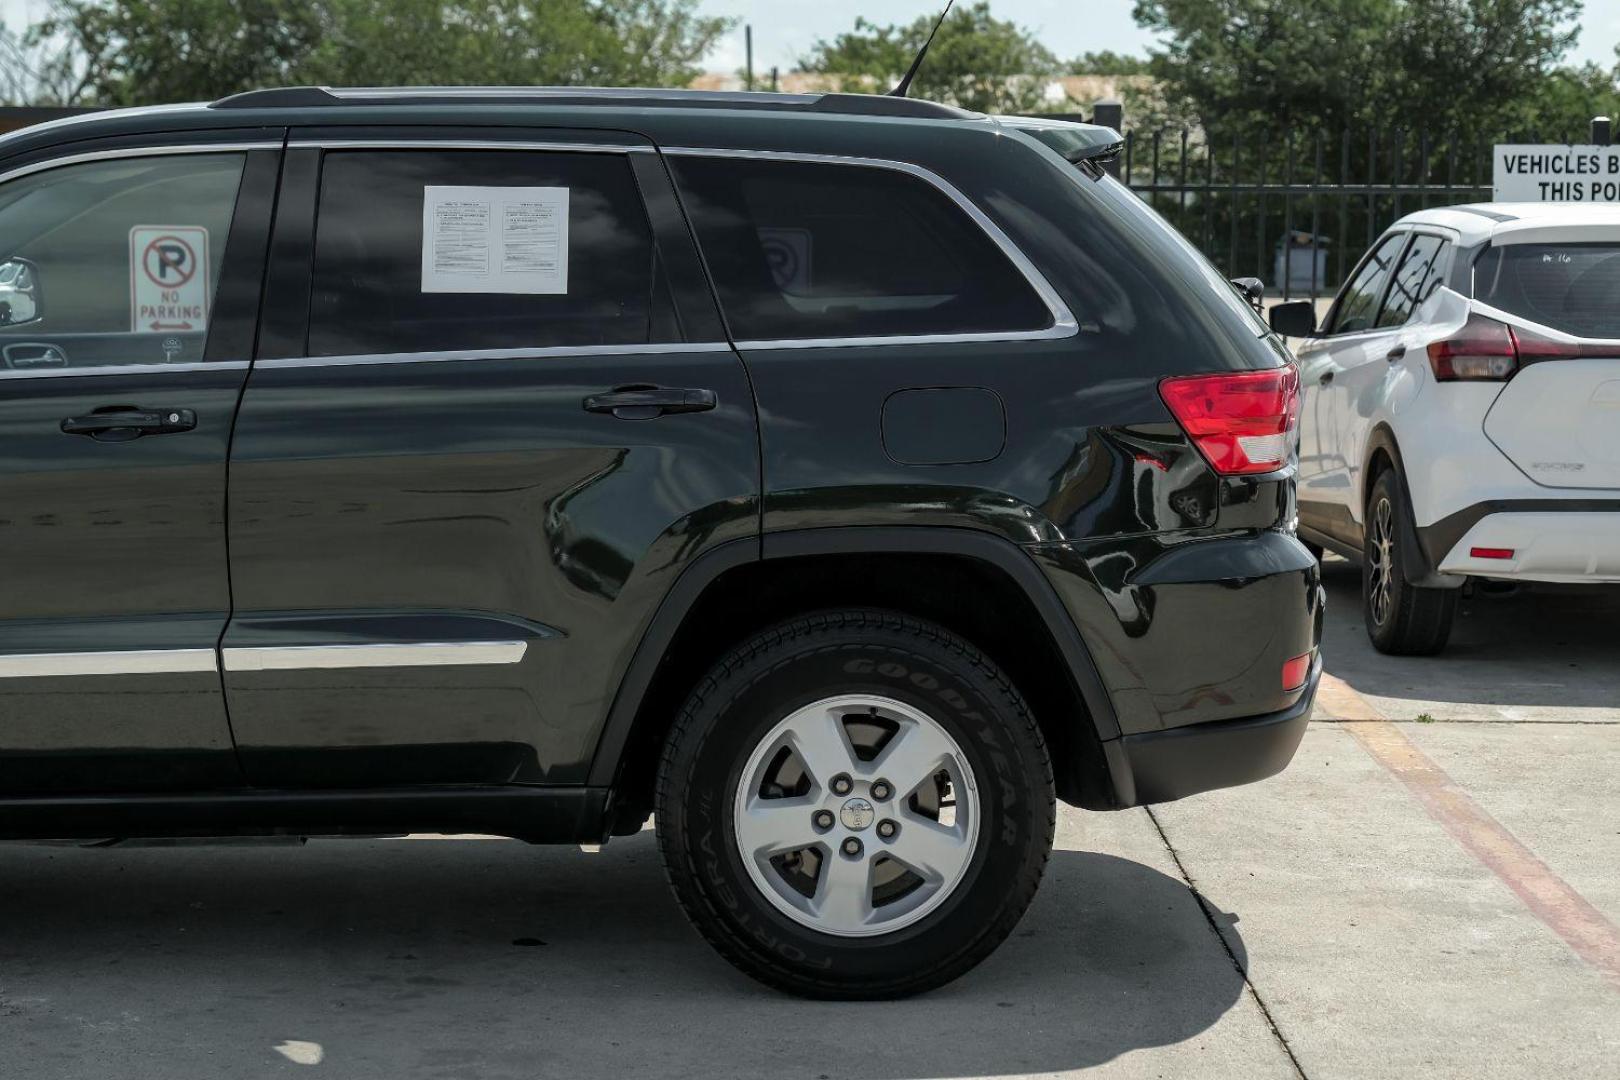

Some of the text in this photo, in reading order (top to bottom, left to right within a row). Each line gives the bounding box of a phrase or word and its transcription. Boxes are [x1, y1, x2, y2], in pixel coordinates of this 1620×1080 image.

[1503, 154, 1600, 175] VEHICLES
[1538, 181, 1620, 201] THIS PO
[161, 291, 179, 303] NO
[140, 305, 202, 319] PARKING
[842, 658, 1018, 847] GOODYEAR
[699, 828, 833, 969] FORTERA
